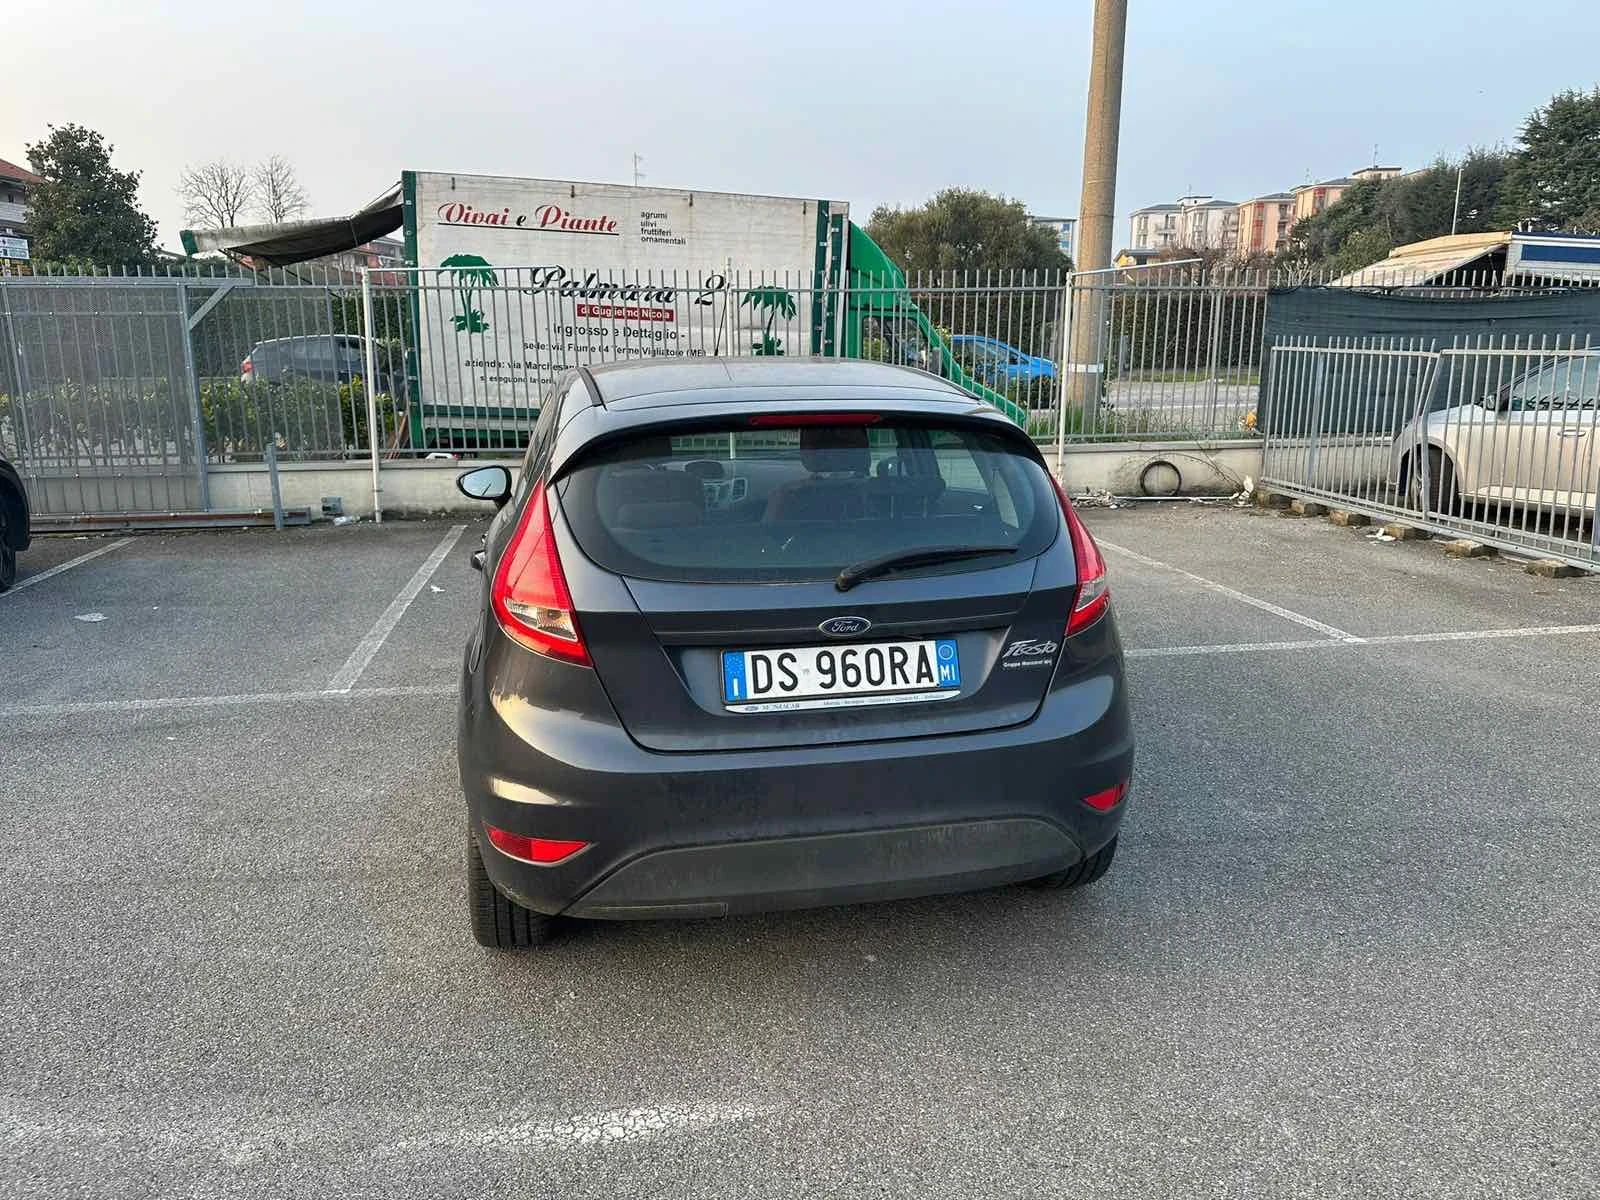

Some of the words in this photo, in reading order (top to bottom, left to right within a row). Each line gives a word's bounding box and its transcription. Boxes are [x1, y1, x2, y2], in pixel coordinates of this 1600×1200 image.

[438, 202, 510, 225] Vivai
[516, 213, 527, 227] e
[534, 204, 618, 233] Piante
[641, 211, 668, 220] agrumi
[641, 228, 672, 237] fruttiferi
[641, 236, 687, 245] ornamentali
[694, 274, 725, 306] 2
[592, 306, 641, 318] Gugielmo
[613, 328, 620, 337] e
[623, 326, 678, 342] Dettagio
[641, 346, 685, 358] Vigliatoe
[529, 377, 553, 385] laori
[831, 620, 860, 633] Ford
[1002, 639, 1058, 659] Fiesta
[751, 652, 799, 694] DS
[815, 644, 935, 690] 960RA
[939, 664, 956, 682] MI
